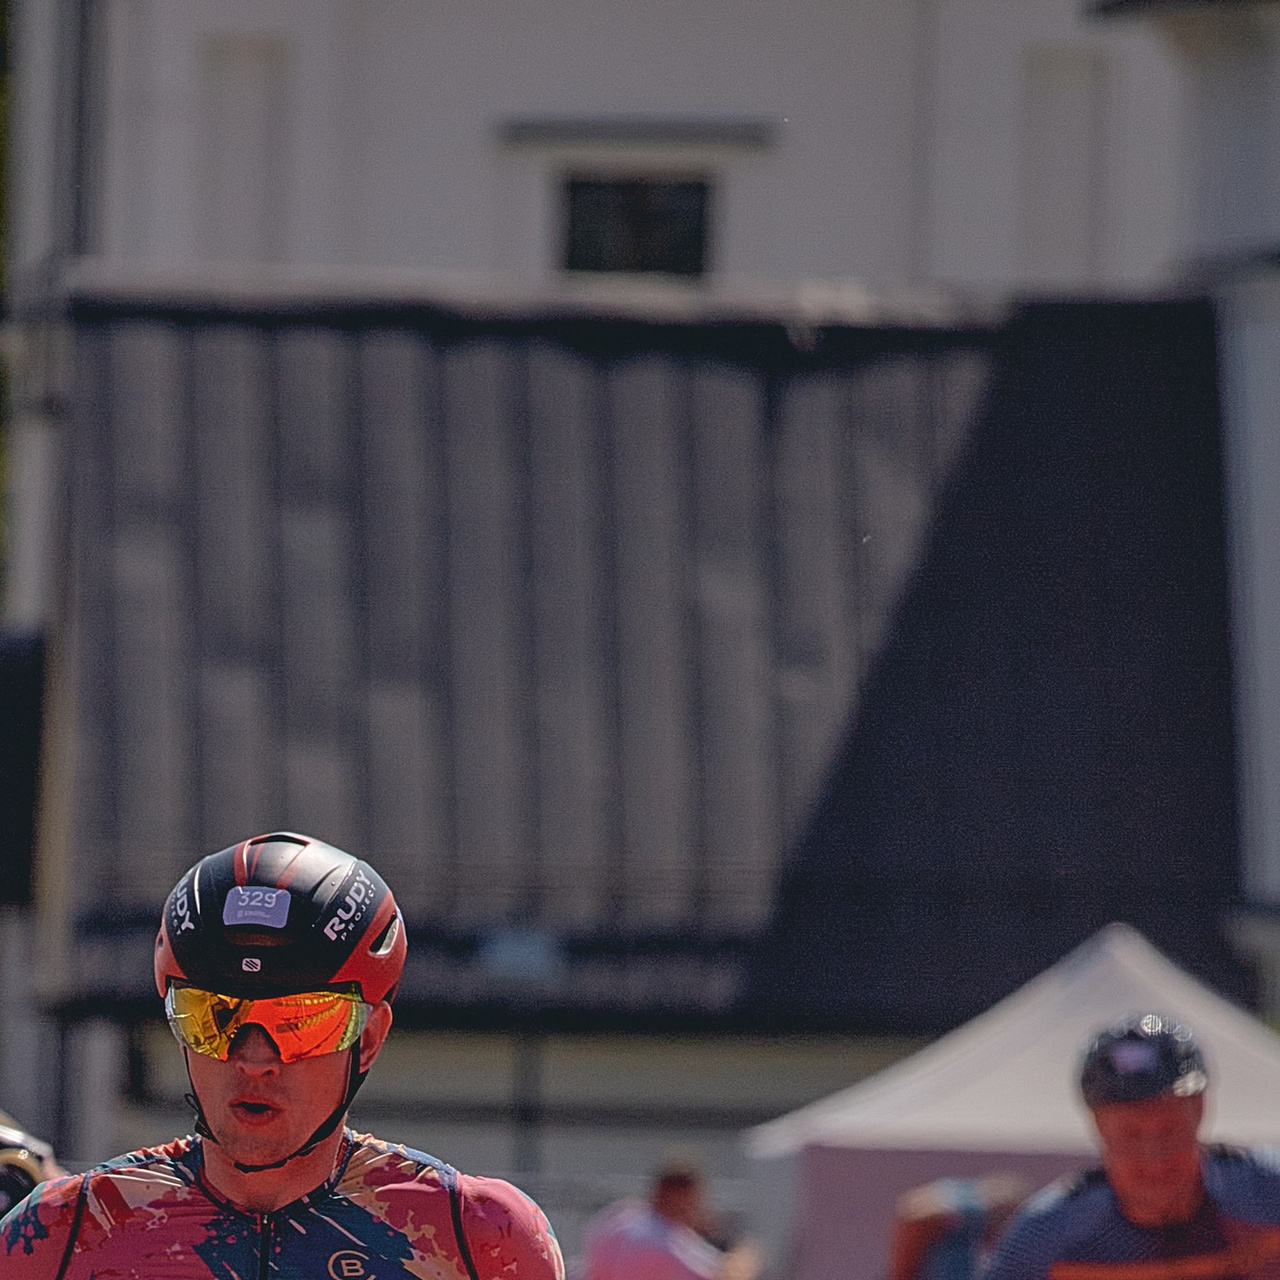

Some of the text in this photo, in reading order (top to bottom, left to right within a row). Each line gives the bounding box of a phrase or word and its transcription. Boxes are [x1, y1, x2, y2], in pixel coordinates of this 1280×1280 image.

[176, 877, 195, 931] UDY
[237, 890, 276, 909] 329
[323, 869, 371, 941] RUDY
[340, 883, 377, 941] PROJECT
